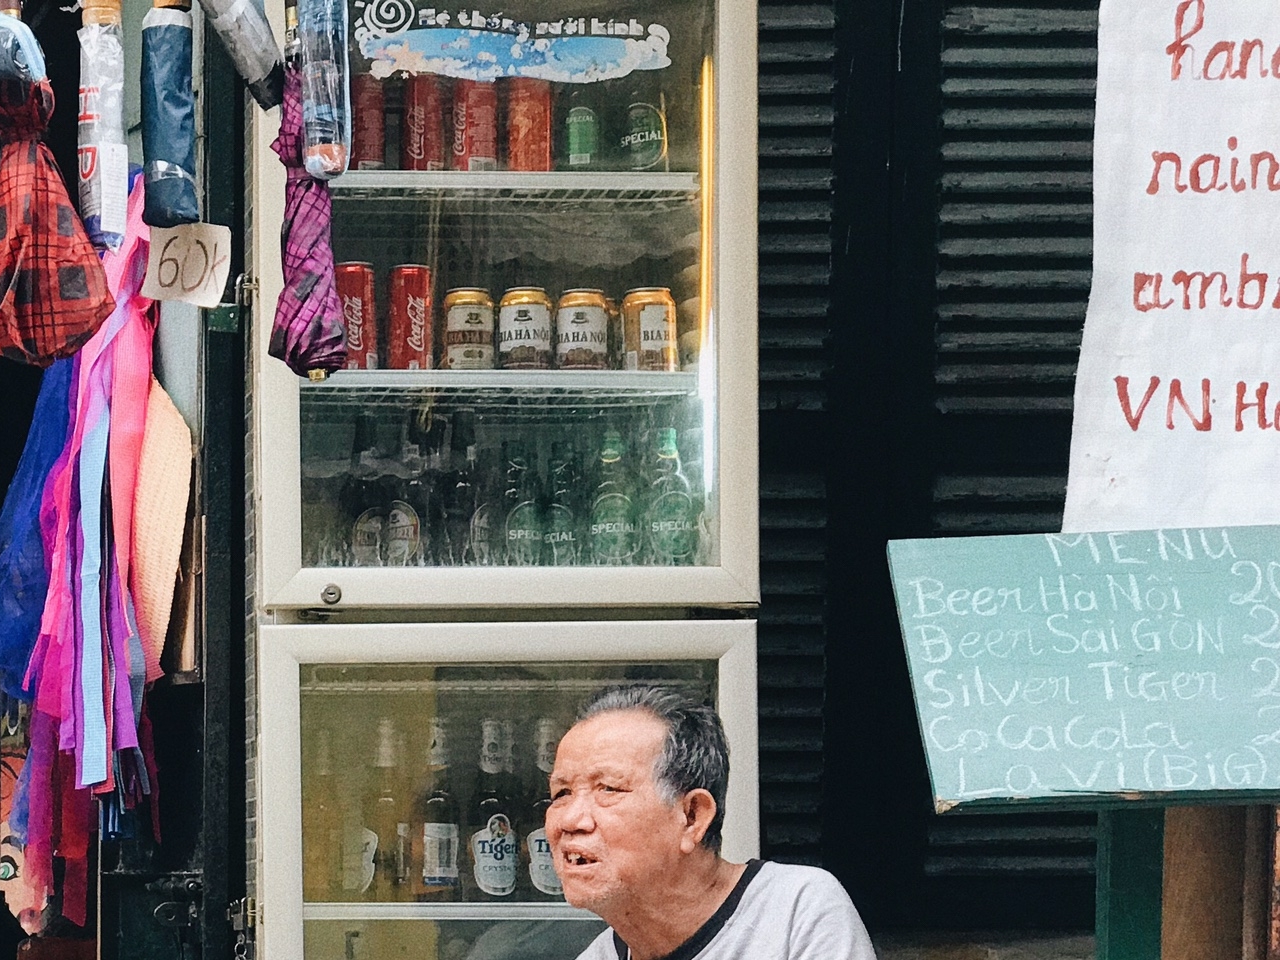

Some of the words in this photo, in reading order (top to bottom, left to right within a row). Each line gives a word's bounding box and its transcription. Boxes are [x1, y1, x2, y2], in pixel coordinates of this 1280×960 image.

[1166, 0, 1280, 81] han
[620, 130, 664, 148] SPECIAL
[1133, 253, 1280, 313] umb
[643, 329, 663, 341] BIA
[1114, 376, 1212, 431] VN
